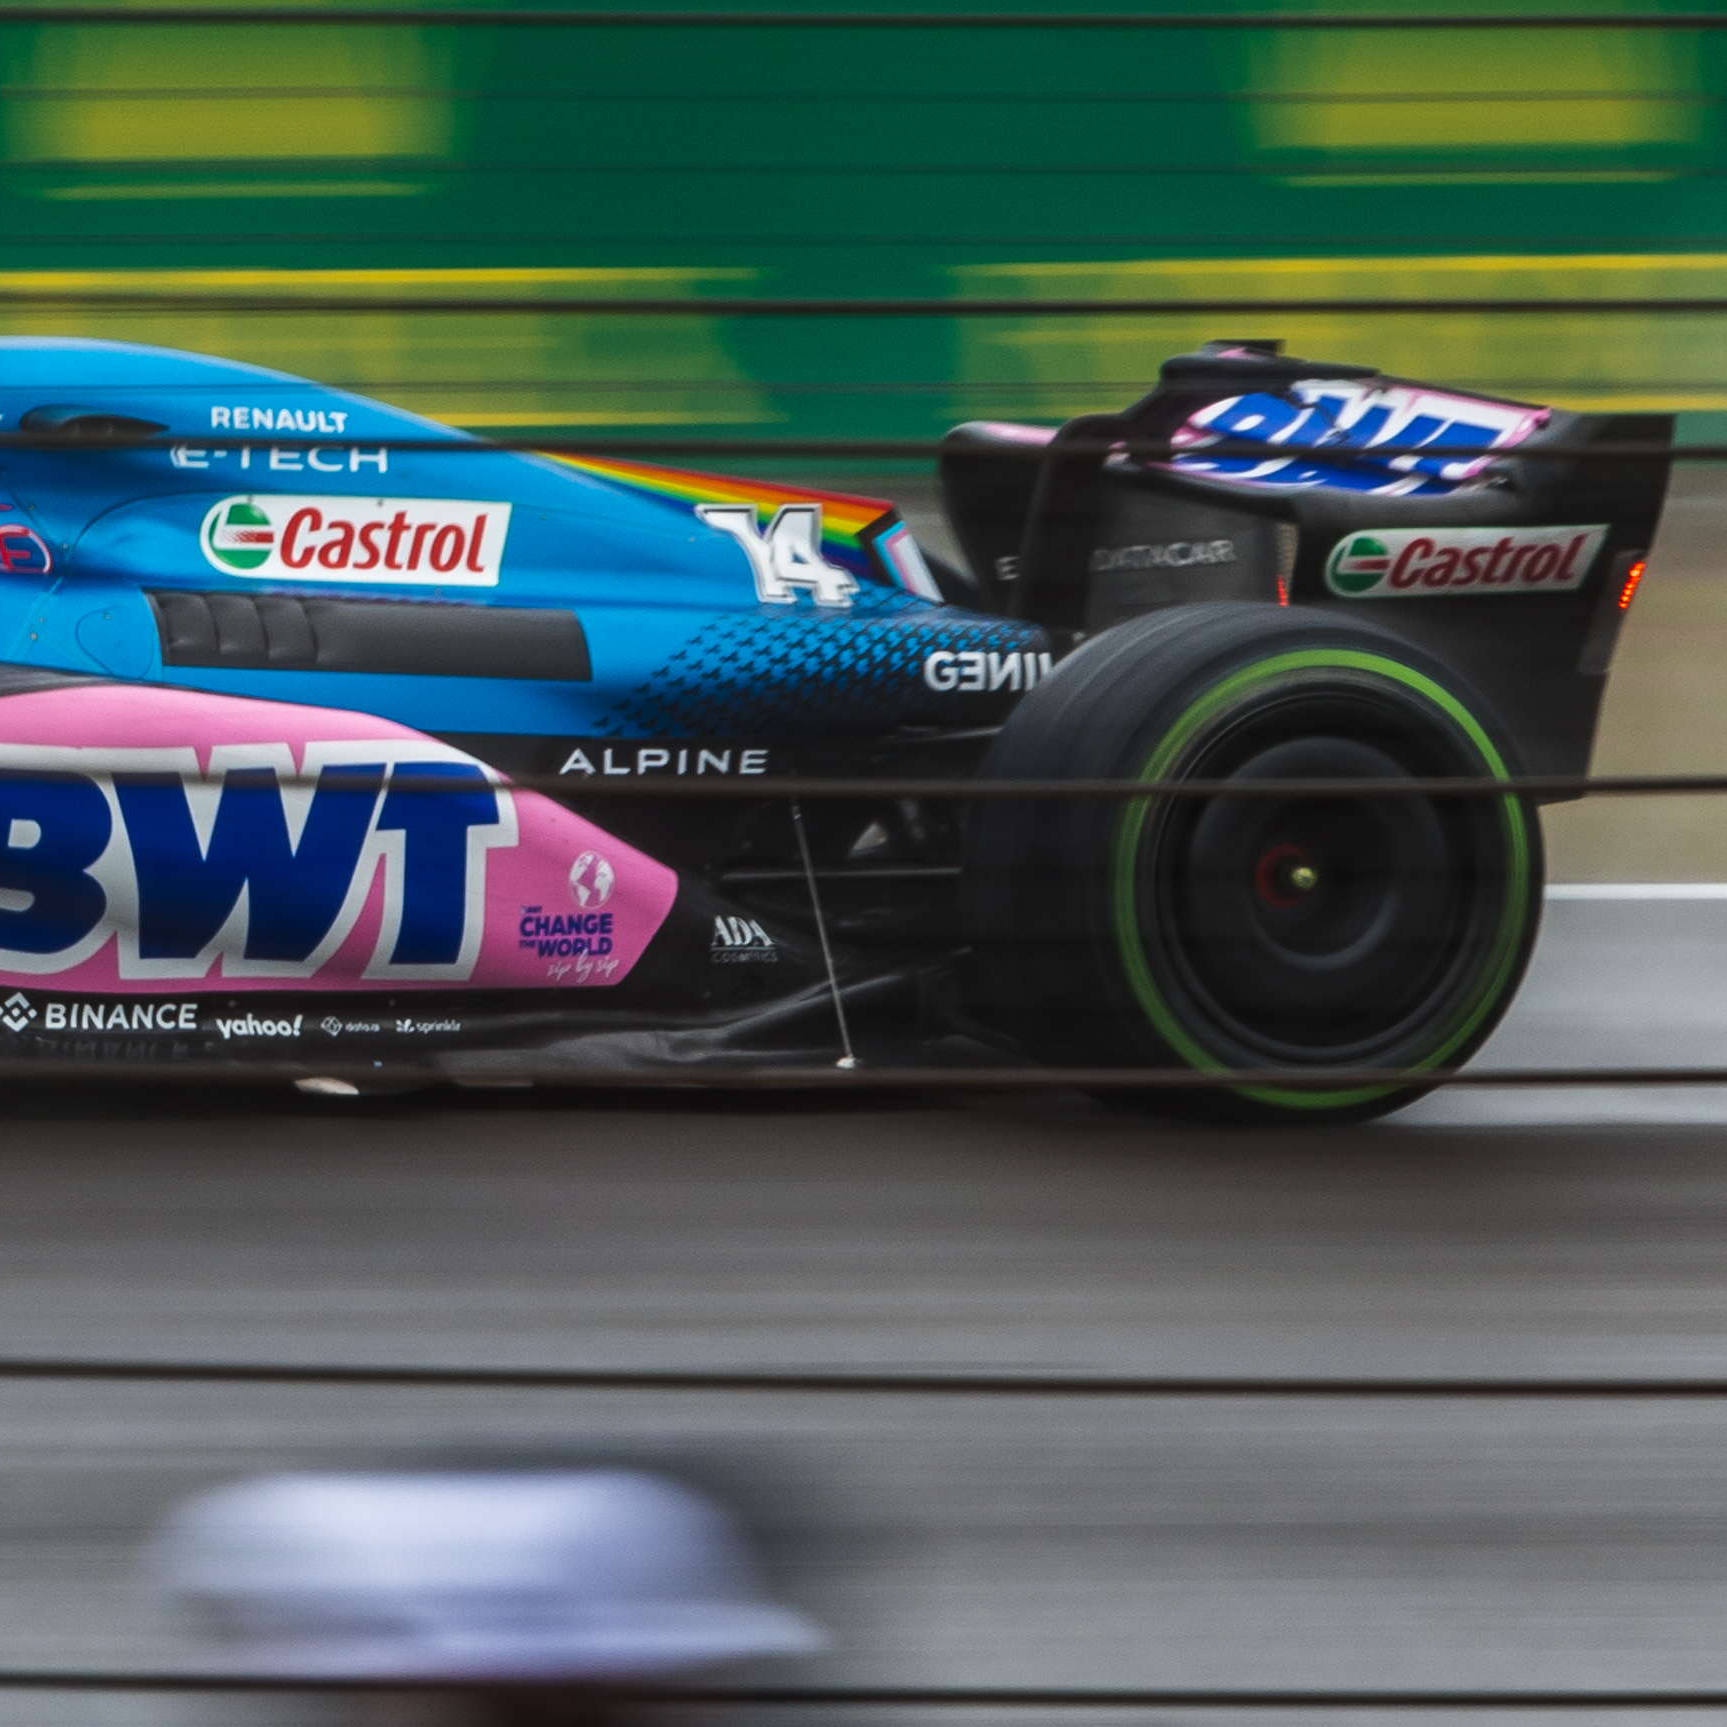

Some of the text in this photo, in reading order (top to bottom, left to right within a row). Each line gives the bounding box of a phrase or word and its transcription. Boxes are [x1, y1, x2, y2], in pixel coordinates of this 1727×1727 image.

[210, 405, 347, 434] RENAULT
[279, 506, 489, 574] Castrol
[694, 502, 861, 607] 14
[1387, 534, 1590, 590] Castrol
[559, 747, 769, 775] ALPINE
[520, 913, 614, 937] CHANGE
[713, 916, 775, 946] ADA
[538, 937, 613, 957] WORLD
[45, 1003, 198, 1030] BINANCE
[216, 1014, 304, 1038] yahoo!
